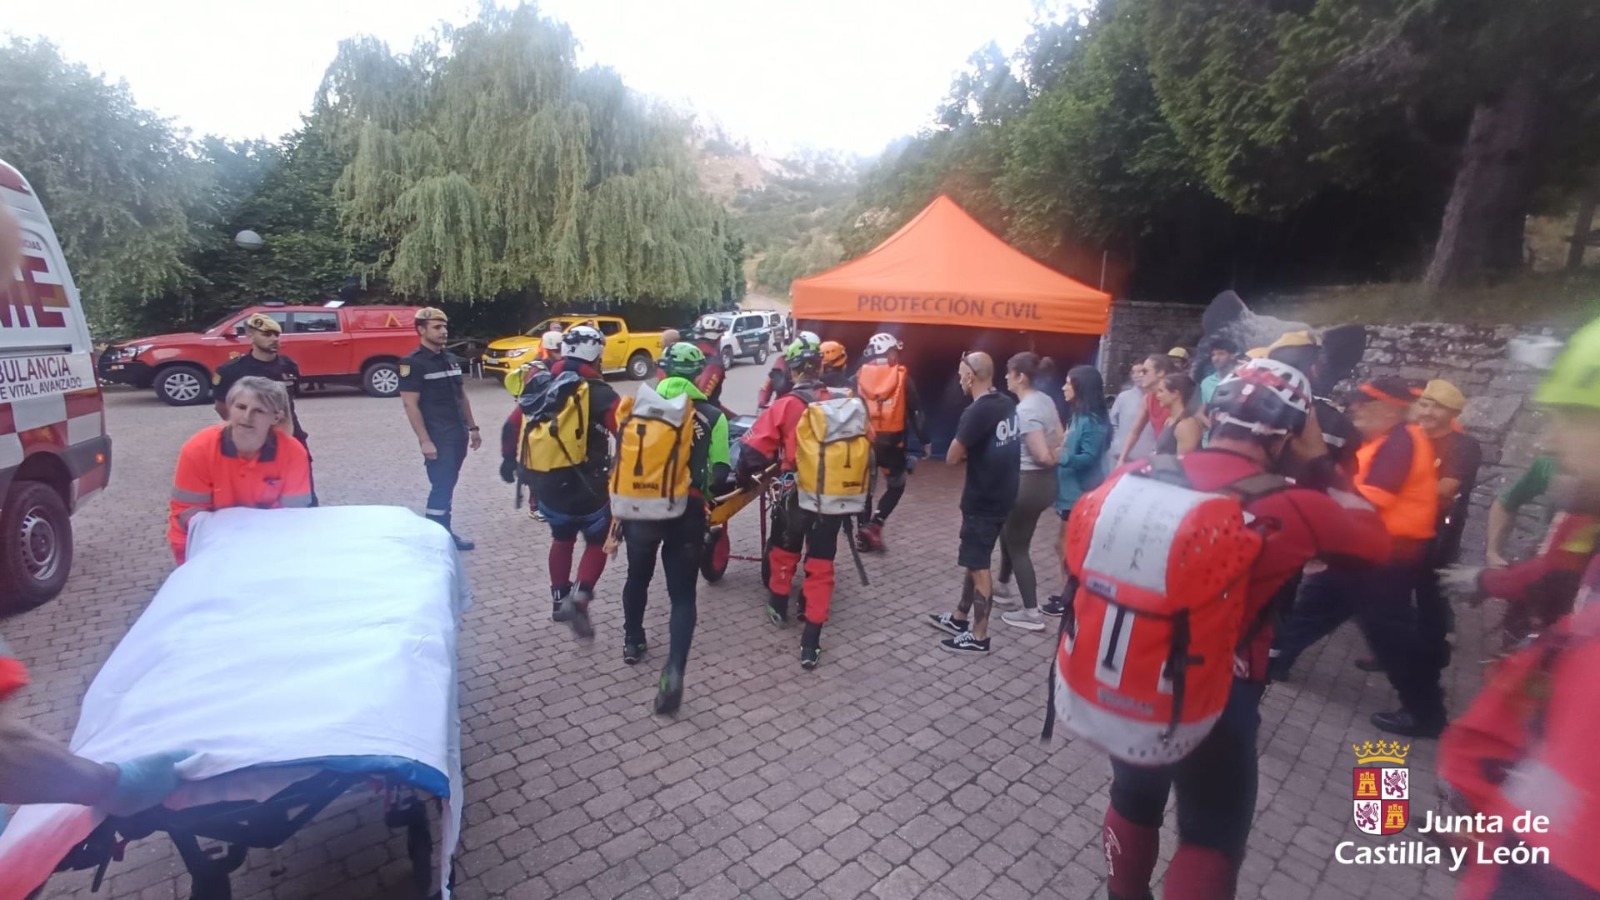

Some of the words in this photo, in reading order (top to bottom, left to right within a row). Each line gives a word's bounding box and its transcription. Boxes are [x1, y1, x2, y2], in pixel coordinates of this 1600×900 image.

[857, 294, 984, 317] PROTECCIÓN
[991, 301, 1042, 320] CIVIL
[9, 383, 38, 398] VITAL
[40, 377, 82, 393] AVANZADO
